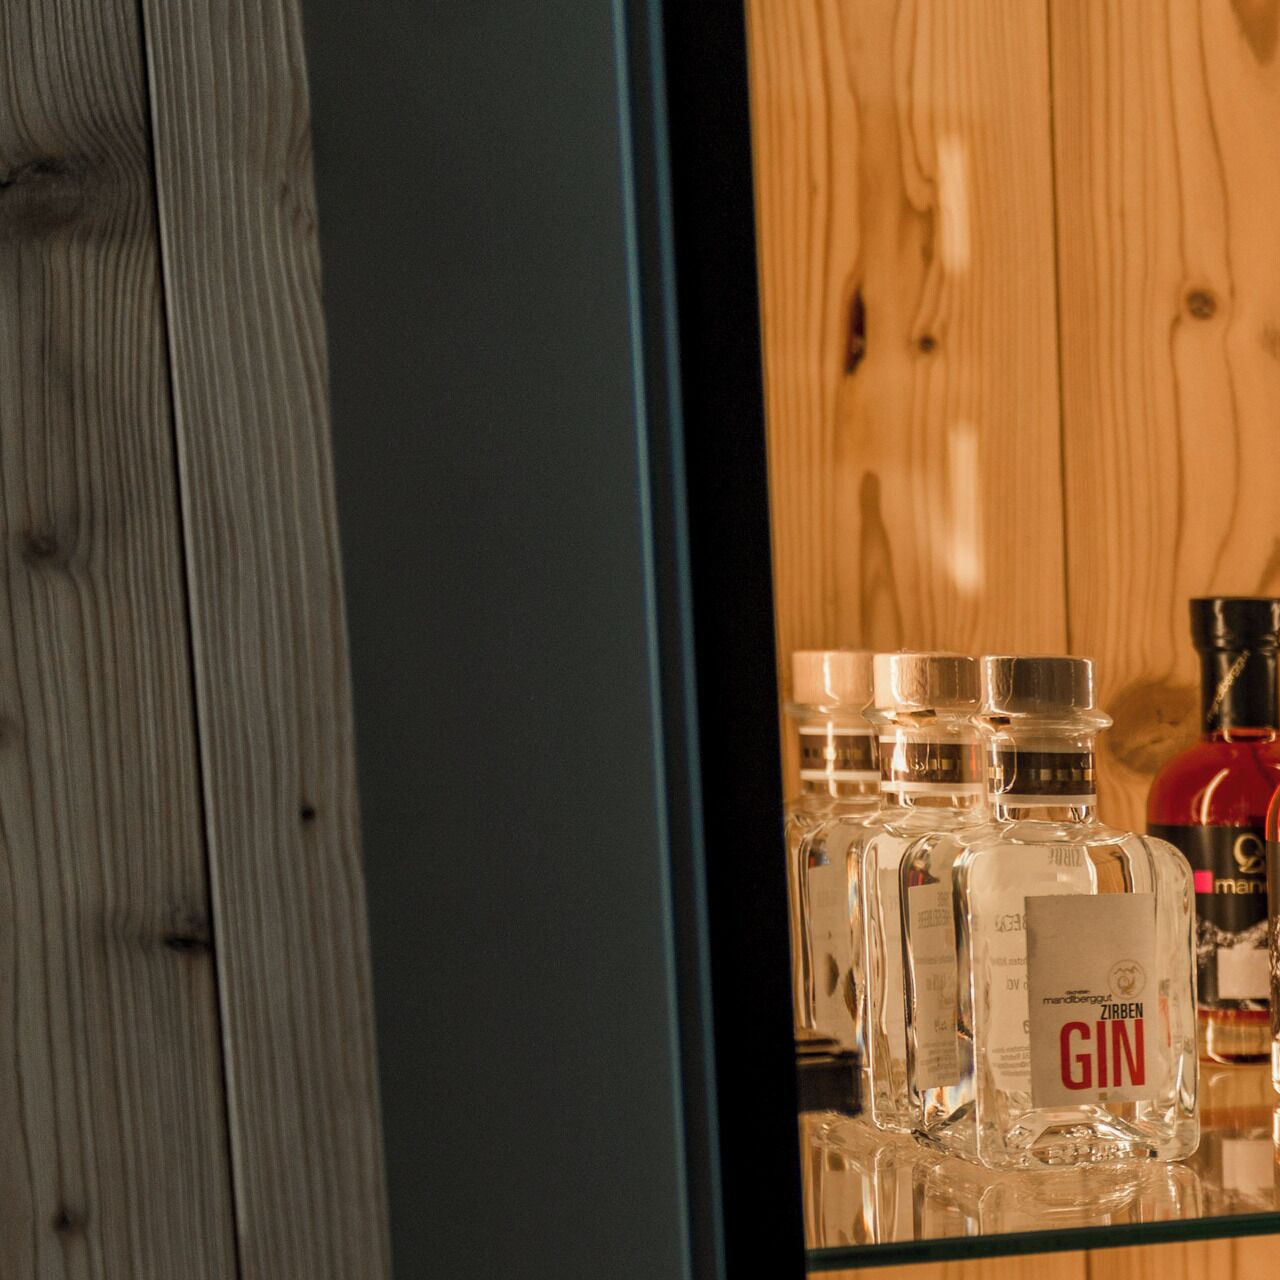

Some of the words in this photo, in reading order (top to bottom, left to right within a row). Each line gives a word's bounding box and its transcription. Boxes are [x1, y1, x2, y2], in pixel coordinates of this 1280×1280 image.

[1043, 991, 1113, 1005] mandlberggut
[1100, 1003, 1144, 1020] ZIRBEN
[1060, 1018, 1145, 1090] GIN
